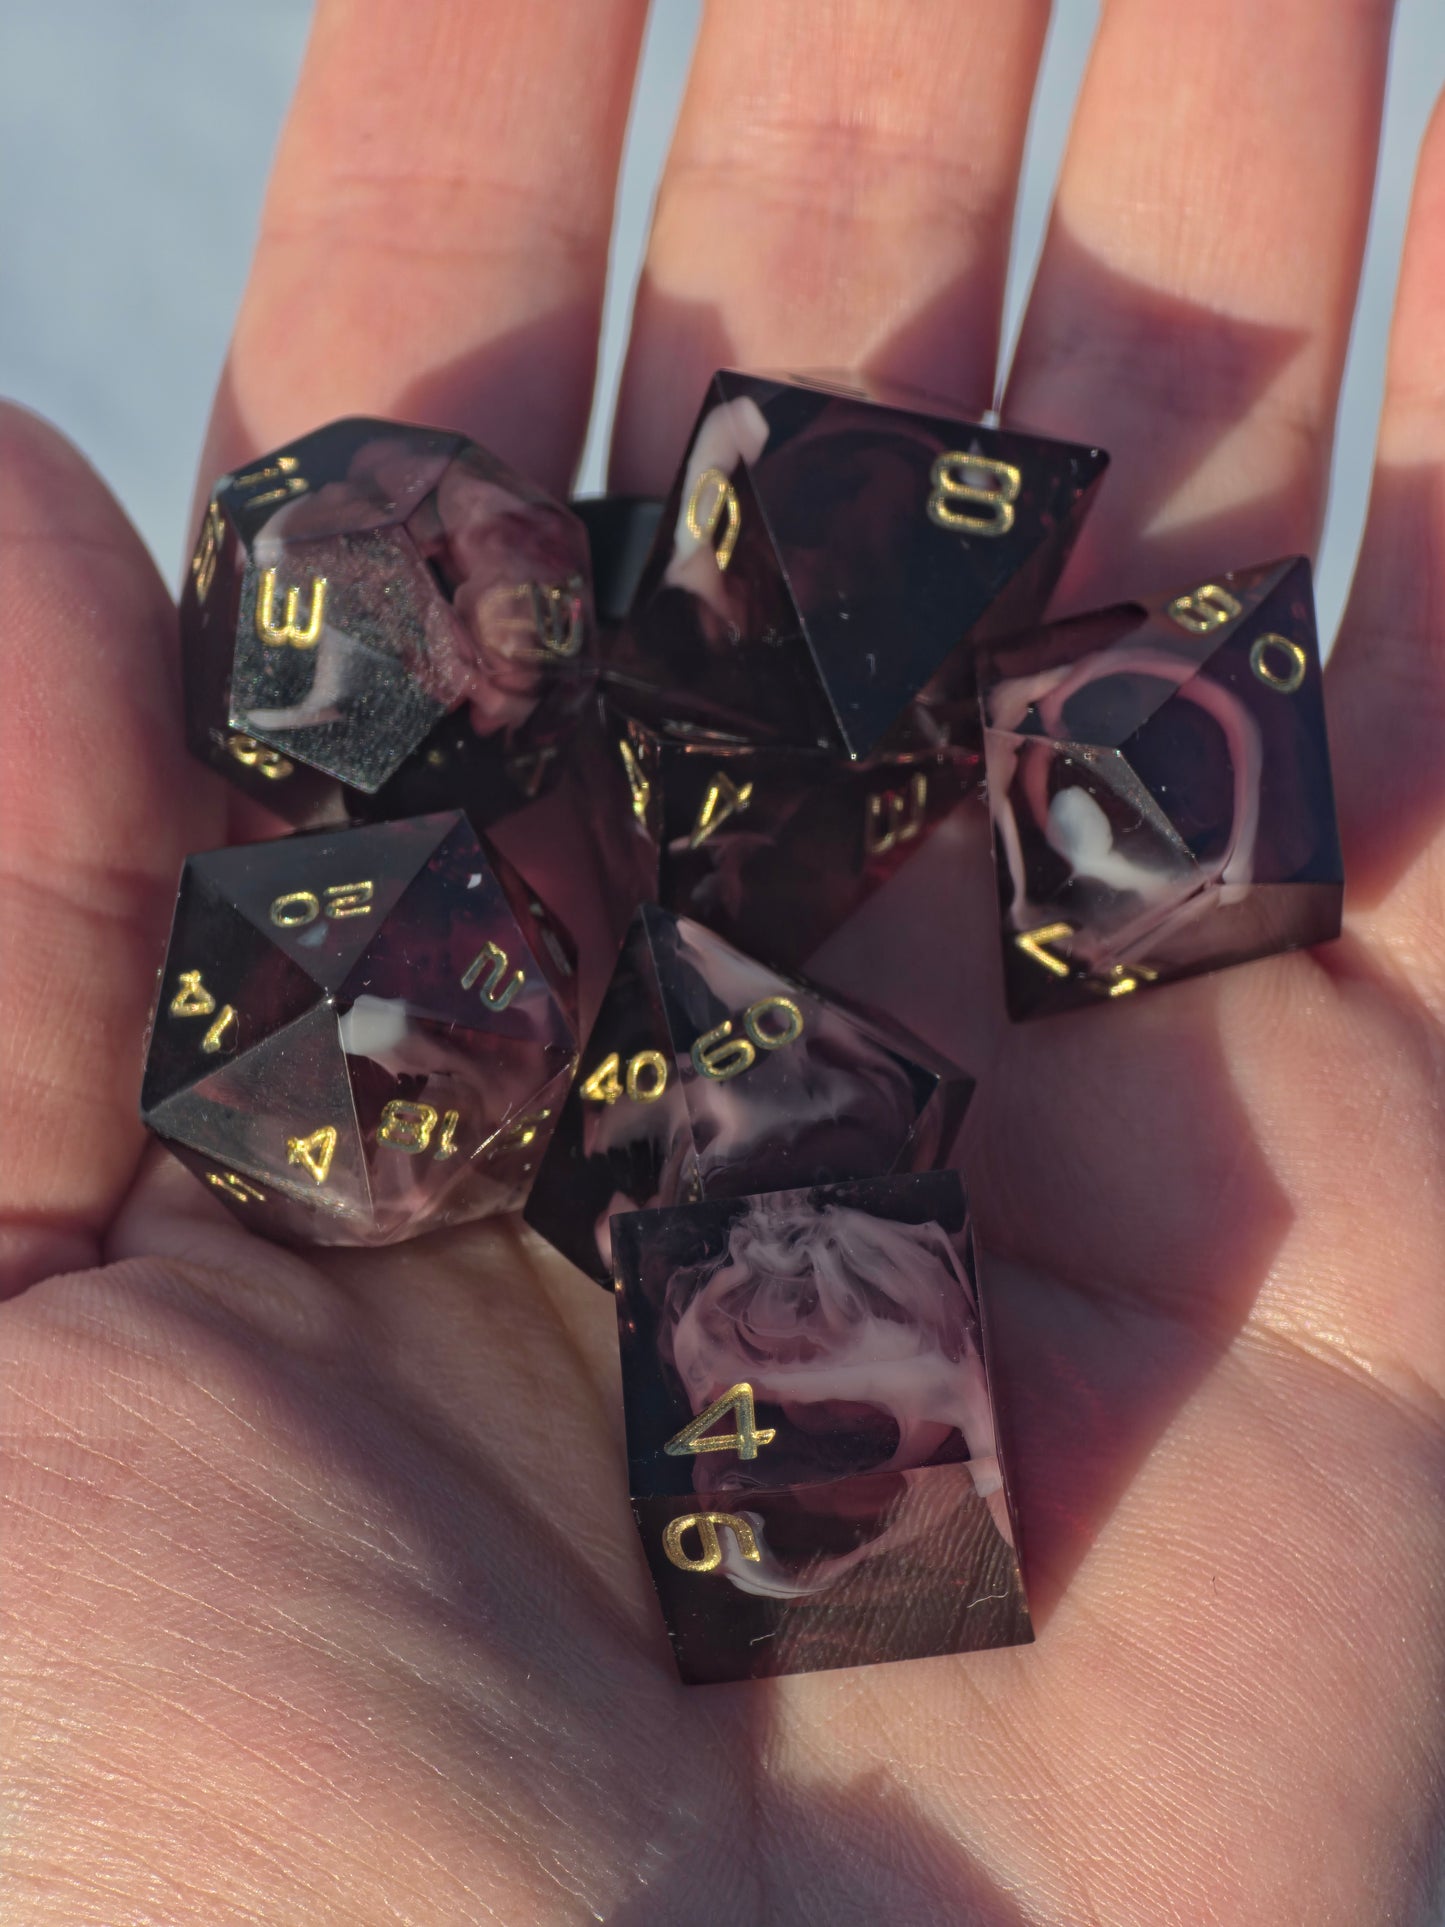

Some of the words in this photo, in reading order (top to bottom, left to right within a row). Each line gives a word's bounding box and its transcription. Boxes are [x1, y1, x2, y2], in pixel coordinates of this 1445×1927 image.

[927, 450, 1022, 537] 8
[256, 567, 326, 650] 3
[270, 880, 374, 928] 20
[691, 996, 804, 1082] 60
[580, 1050, 668, 1105] 40
[287, 1126, 337, 1183] 4
[377, 1099, 459, 1160] 18
[664, 1382, 776, 1460] 4
[662, 1512, 760, 1572] 6
